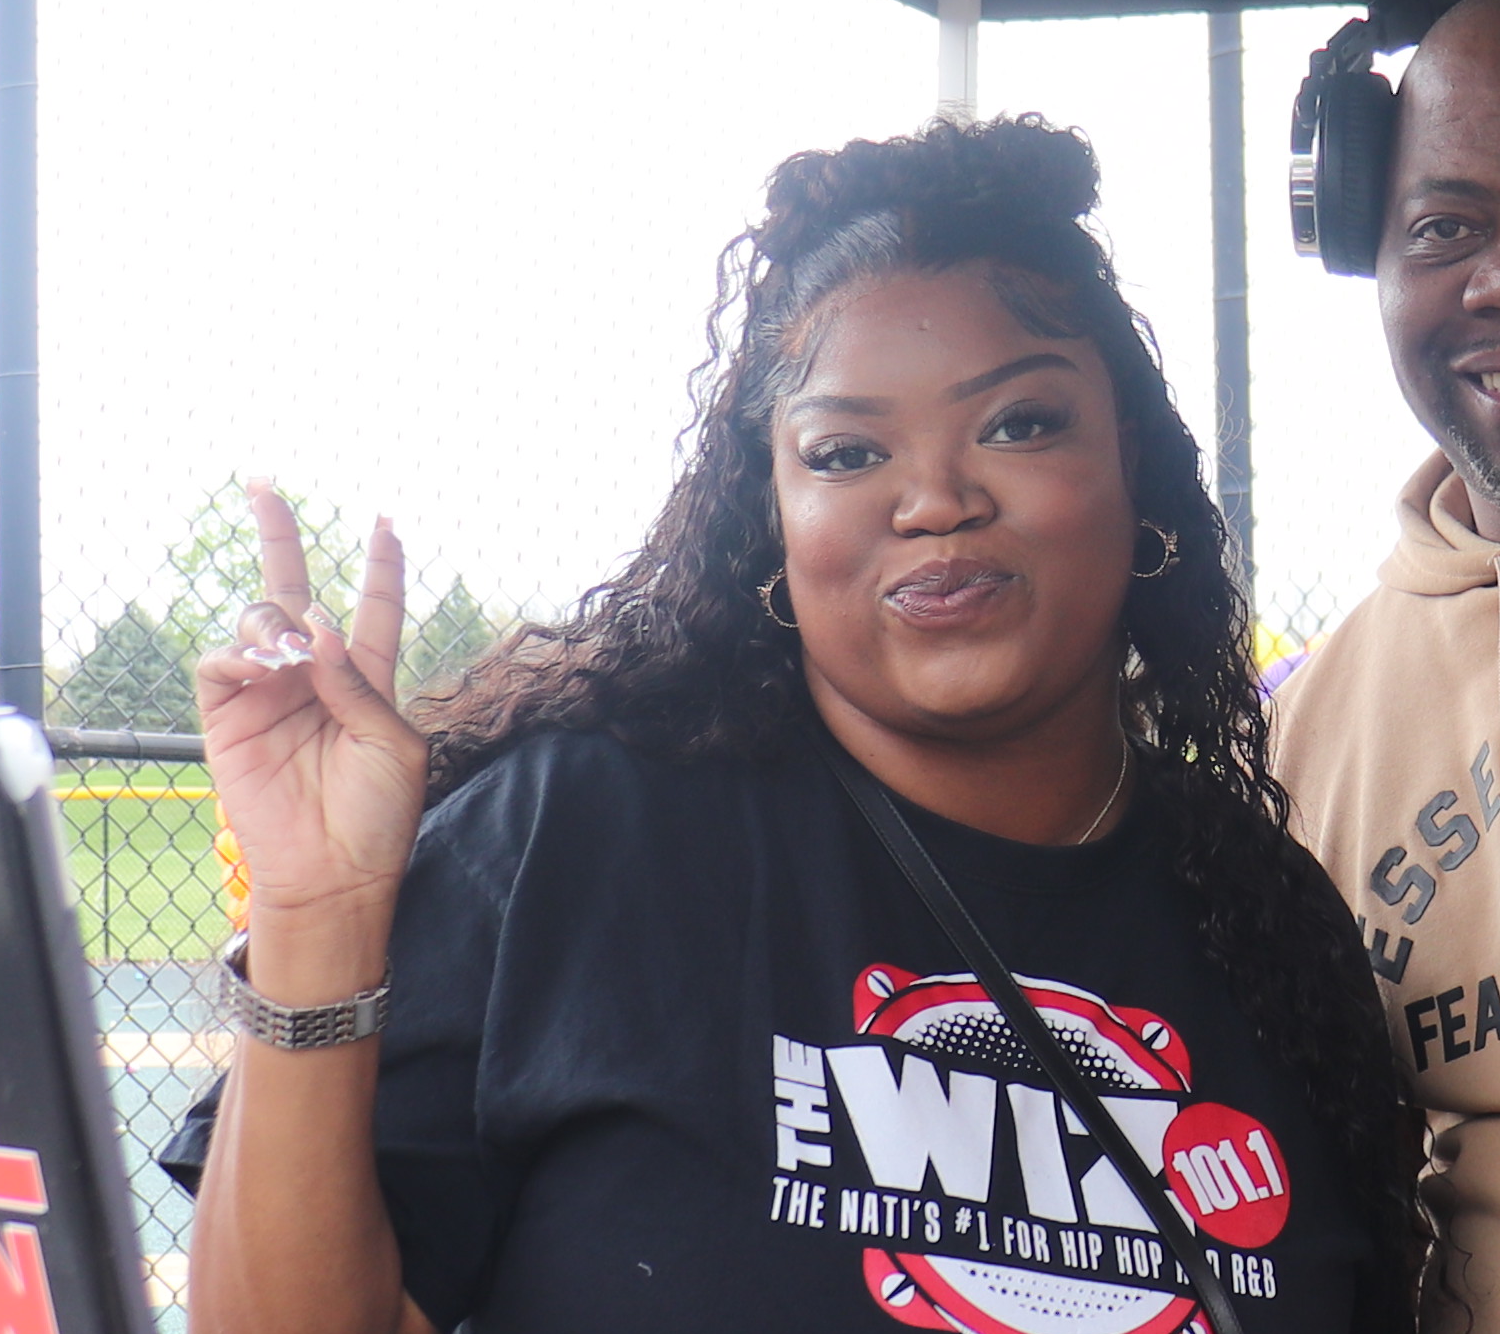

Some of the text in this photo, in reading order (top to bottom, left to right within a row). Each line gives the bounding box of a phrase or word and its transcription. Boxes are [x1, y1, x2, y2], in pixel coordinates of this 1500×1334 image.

[772, 1034, 832, 1171] THE
[1172, 1129, 1285, 1216] 101.1
[770, 1175, 827, 1229] THE
[839, 1188, 942, 1244] NATI'S
[954, 1206, 991, 1252] #1
[1002, 1215, 1050, 1264] FOR
[1059, 1229, 1103, 1271] HIP
[1114, 1234, 1164, 1280] HOP
[1230, 1252, 1278, 1299] R&B
